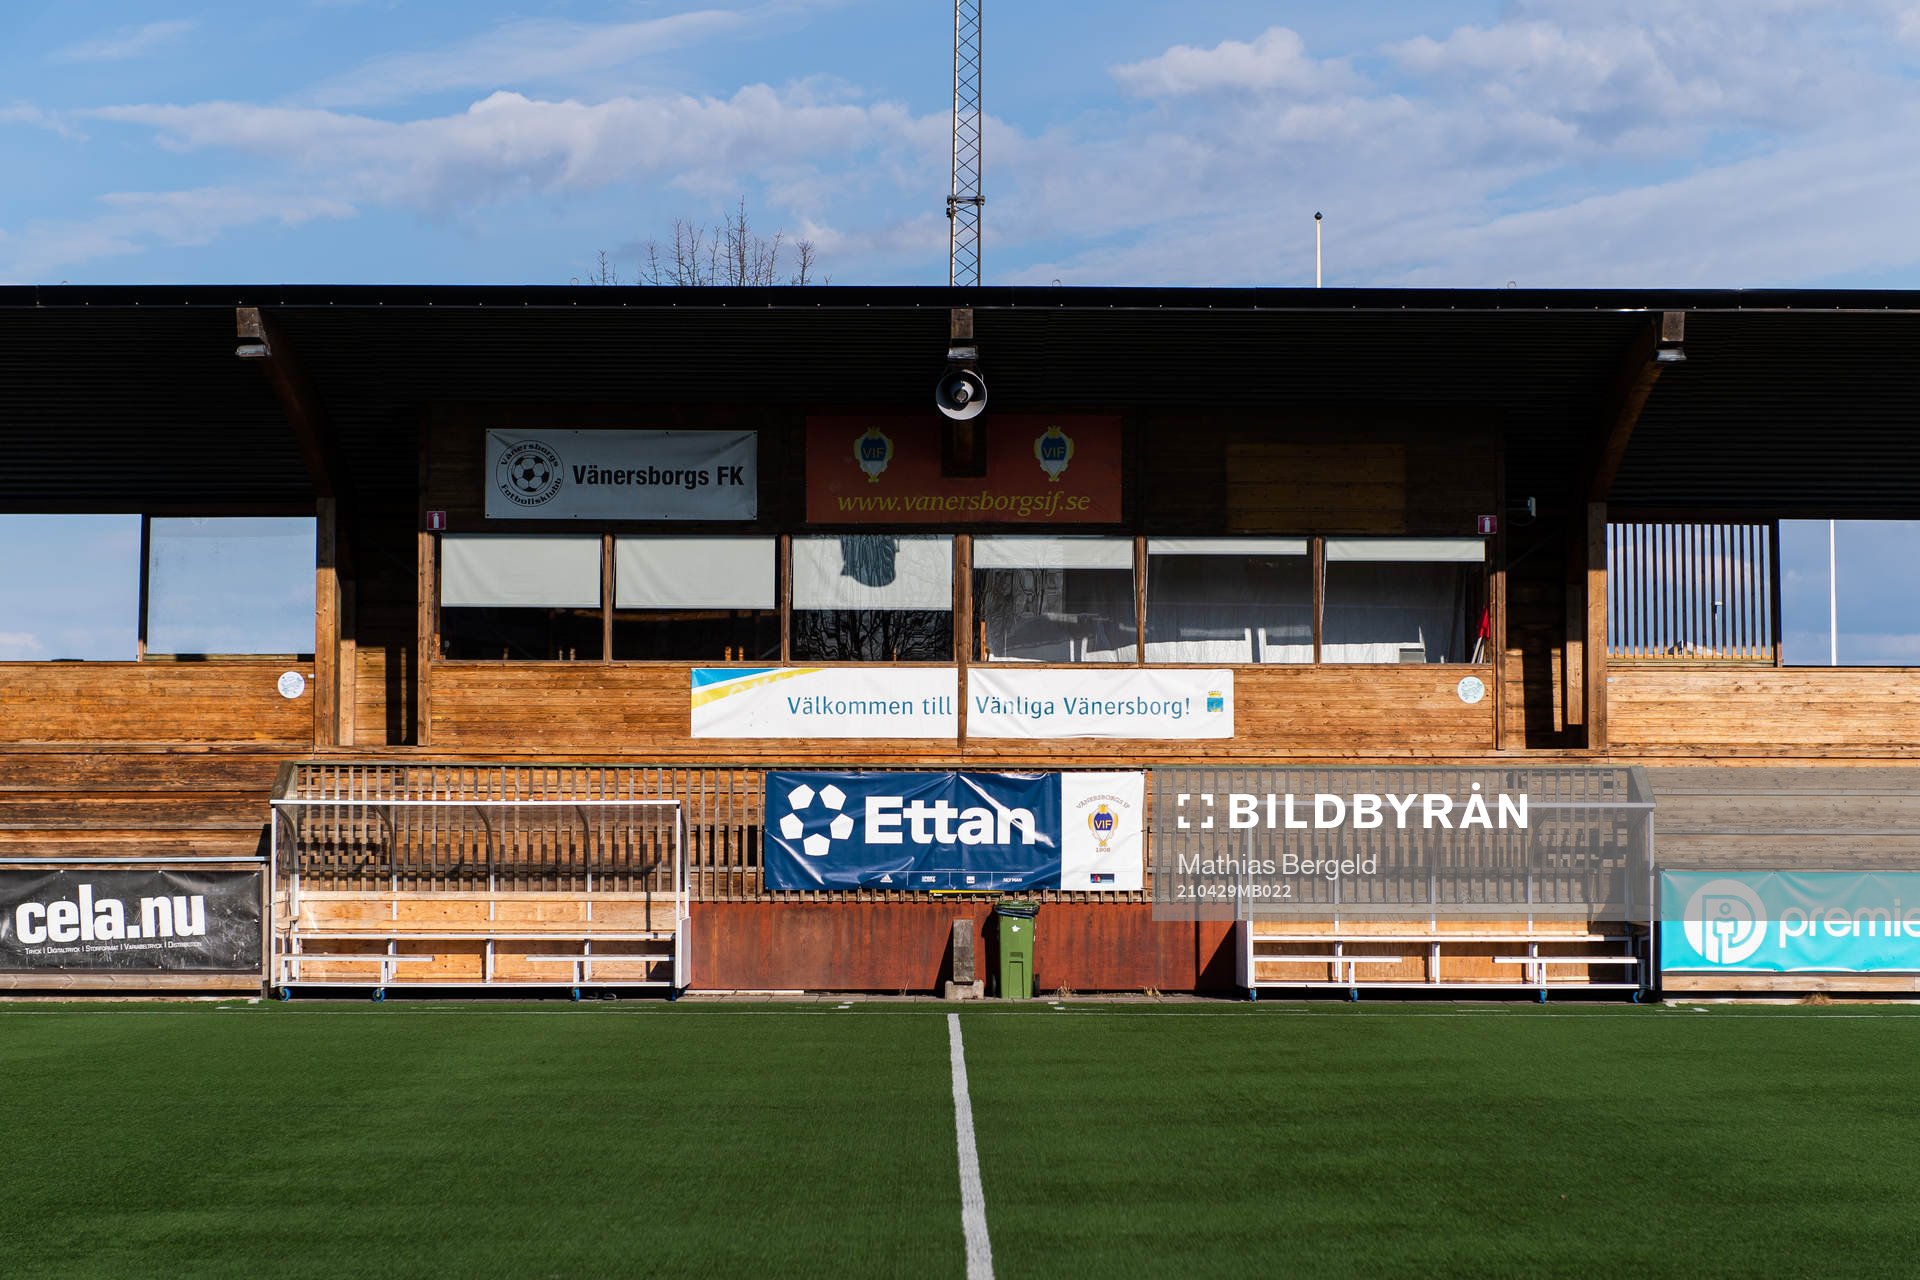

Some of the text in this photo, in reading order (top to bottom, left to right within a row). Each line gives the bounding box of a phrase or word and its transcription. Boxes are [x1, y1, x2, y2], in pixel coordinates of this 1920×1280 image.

[501, 443, 559, 467] Vänersborgs
[862, 447, 885, 458] VIF
[1043, 446, 1066, 458] VIF
[573, 465, 745, 490] Vänersborgs FK
[501, 478, 562, 505] Fotbollsklubb
[838, 490, 1091, 517] www.vanersborgsif.se
[787, 695, 1191, 719] Välkommen till Vänliga Vänersborg!
[864, 795, 1036, 846] Ettan
[1095, 820, 1112, 829] VIF
[16, 884, 206, 944] cela.nu
[1779, 898, 1920, 948] premie
